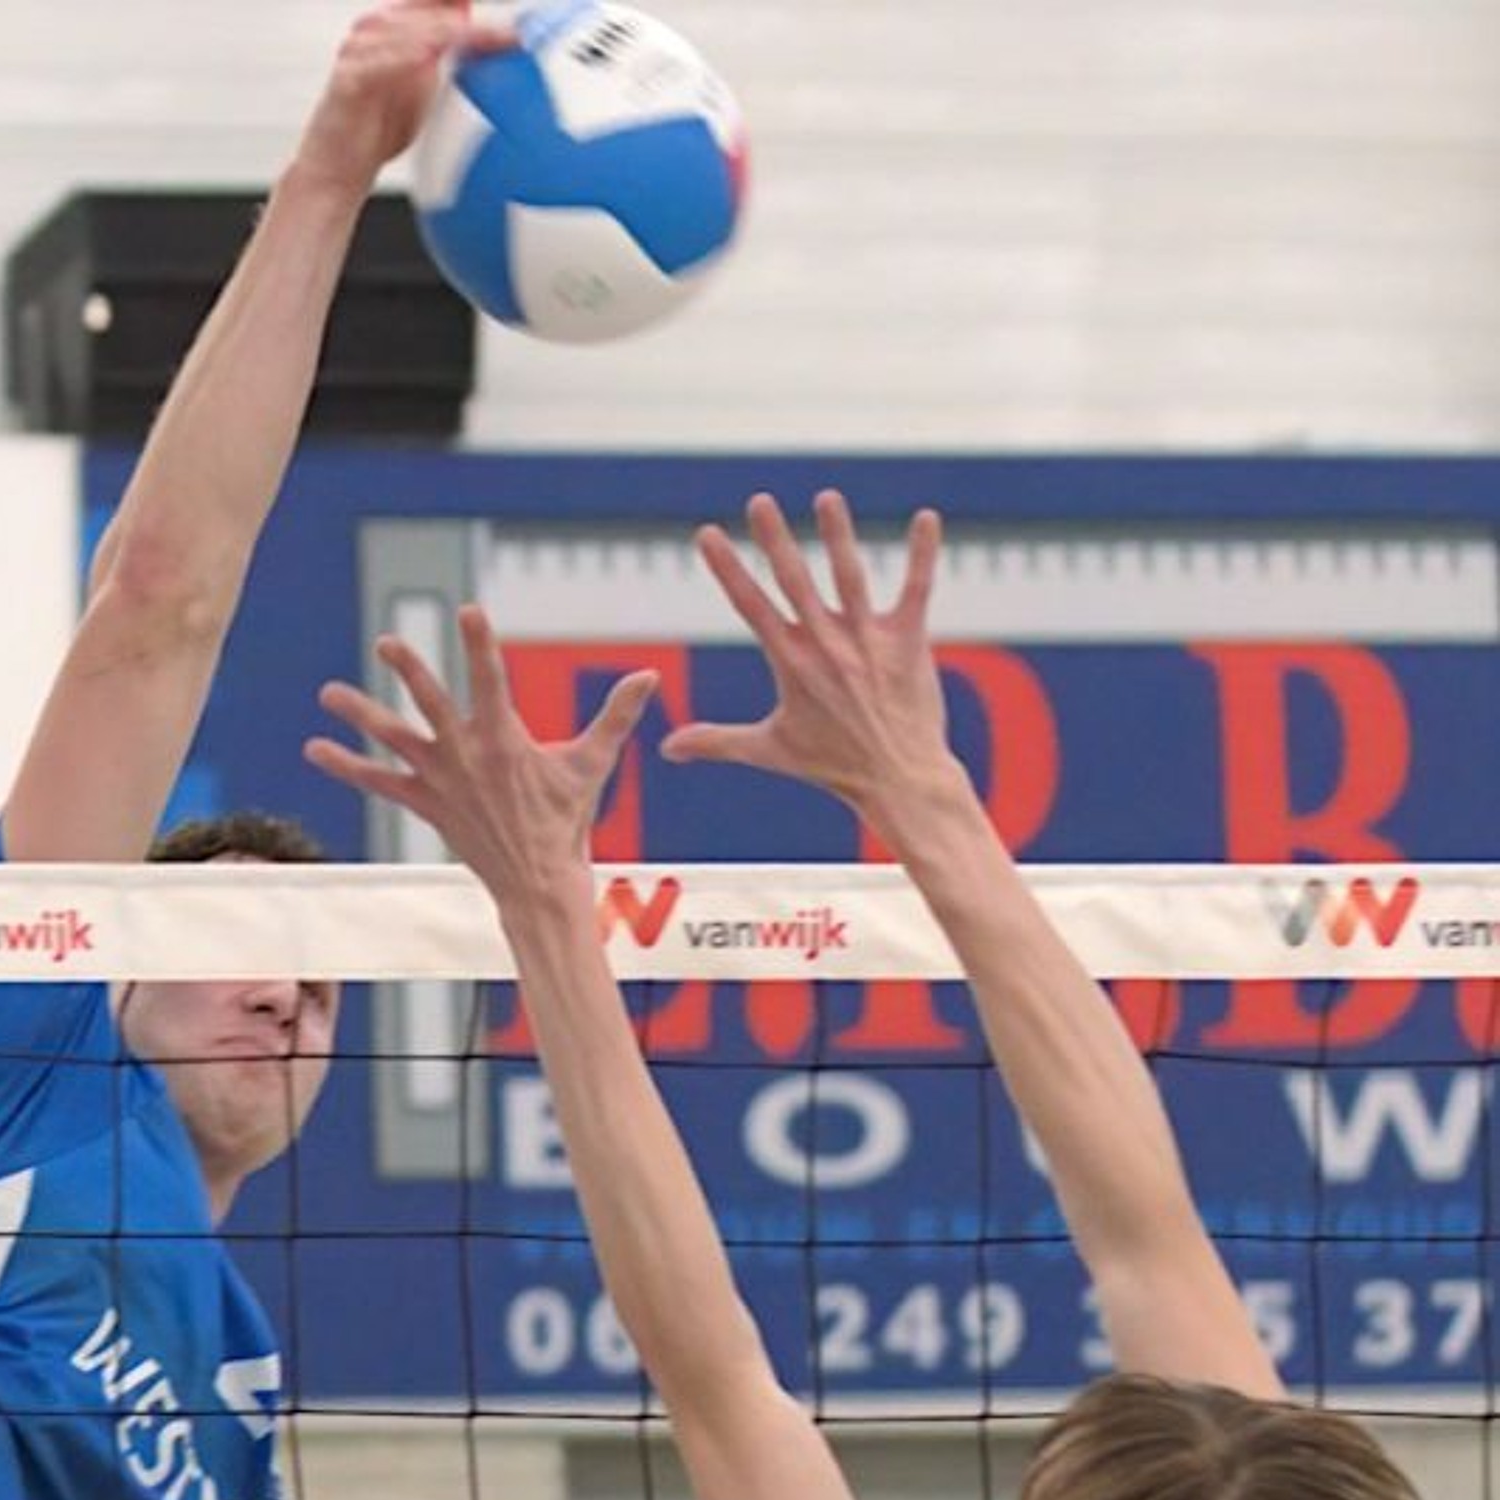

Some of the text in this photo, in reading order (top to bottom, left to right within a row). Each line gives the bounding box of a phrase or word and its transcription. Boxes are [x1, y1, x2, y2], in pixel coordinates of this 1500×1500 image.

[683, 908, 848, 960] vanwijk
[1421, 920, 1500, 947] van
[816, 1283, 1024, 1373] 249
[1351, 1279, 1485, 1367] 37
